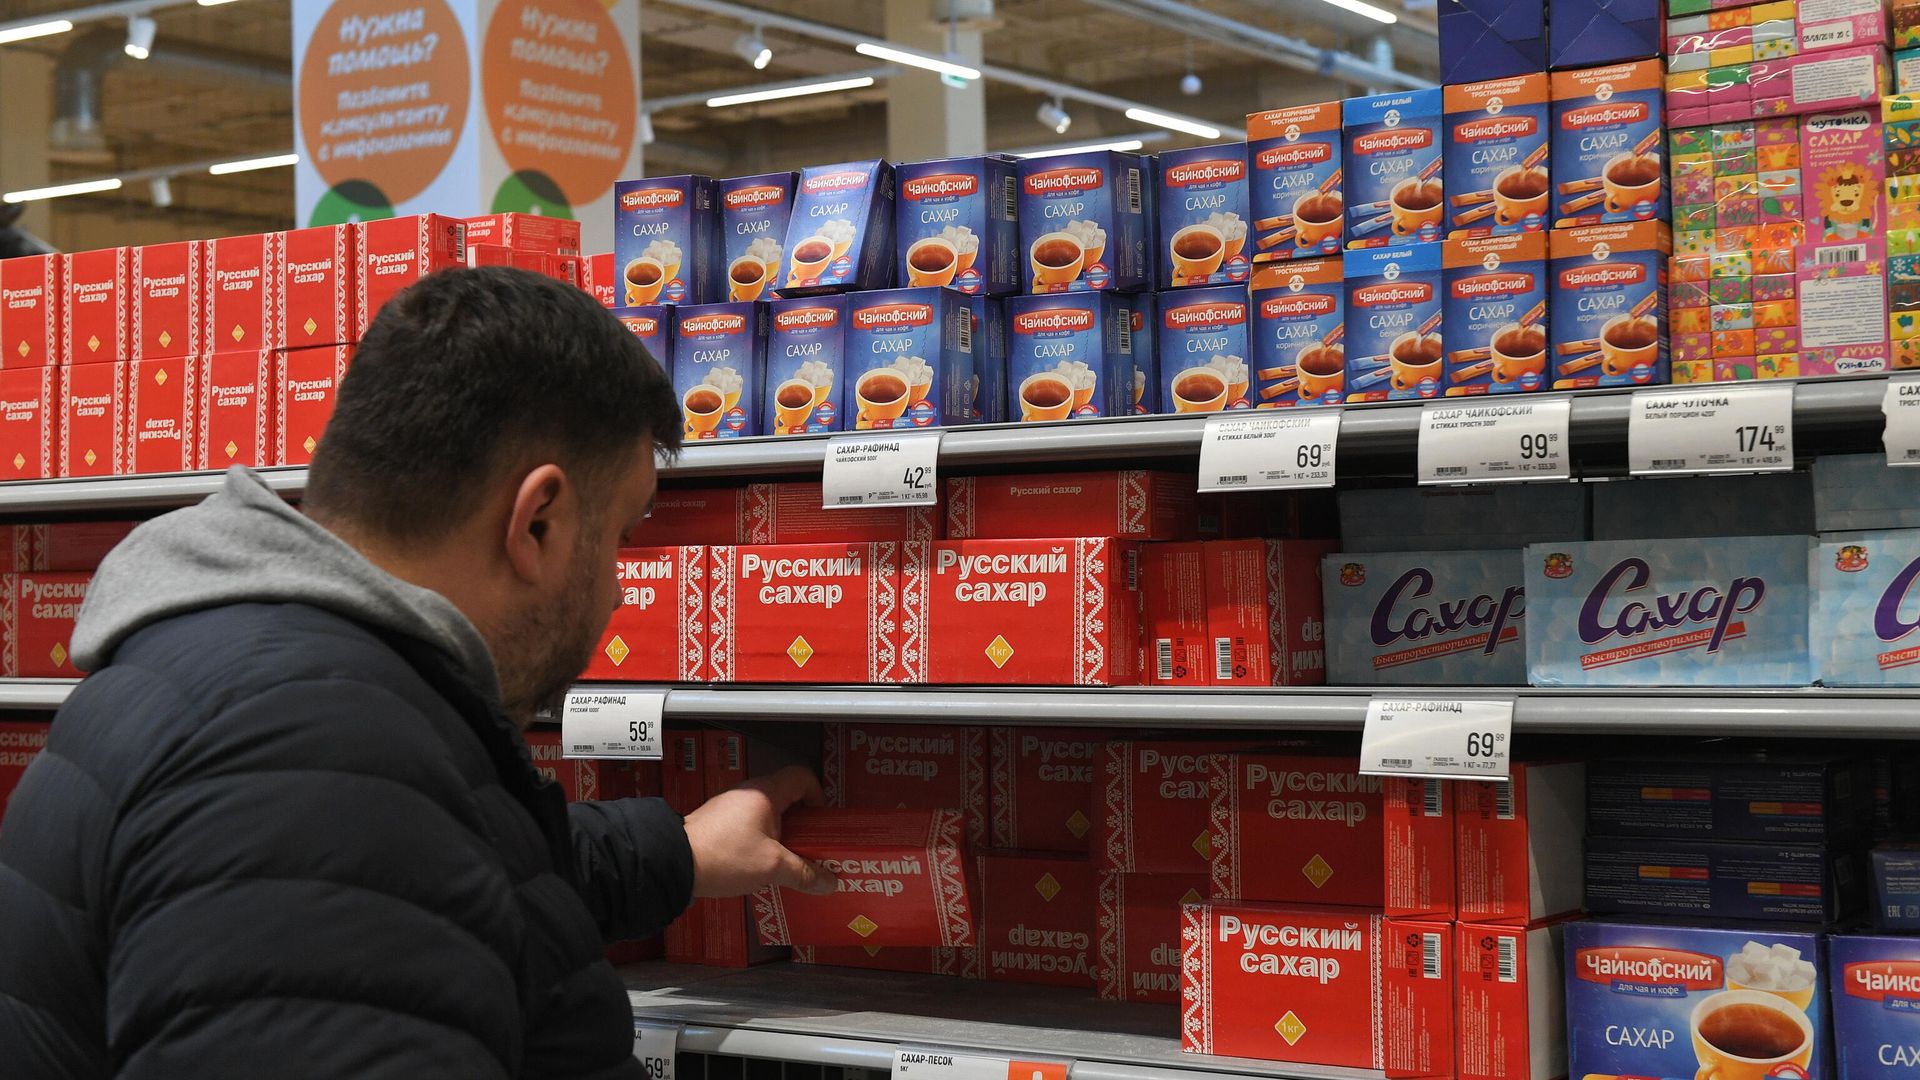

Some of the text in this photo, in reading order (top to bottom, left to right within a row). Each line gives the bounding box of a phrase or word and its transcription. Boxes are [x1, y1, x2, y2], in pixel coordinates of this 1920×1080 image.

[1569, 106, 1640, 126] Чайкофский
[1811, 115, 1868, 129] ЧУТОЧКА
[1461, 119, 1529, 138] Чайкофский
[1360, 131, 1424, 151] Чайкофский
[1580, 133, 1628, 151] САХАР
[1809, 131, 1863, 148] САХАР
[1262, 146, 1324, 166] Чайкофский
[1472, 147, 1518, 164] САХАР
[1171, 162, 1240, 183] Чайкофский
[1370, 159, 1414, 176] САХАР
[806, 173, 865, 191] Чайкофский
[907, 176, 972, 196] Чайкофский
[1029, 170, 1097, 190] Чайкофский
[1273, 173, 1314, 189] САХАР
[623, 188, 680, 207] Чайкофский
[727, 187, 781, 206] Чайкофский
[1185, 194, 1226, 211] САХАР
[810, 203, 848, 217] САХАР
[921, 208, 959, 224] САХАР
[1044, 202, 1085, 219] САХАР
[467, 218, 496, 231] усский
[633, 223, 669, 237] САХАР
[736, 220, 771, 235] САХАР
[368, 249, 415, 266] Русский
[216, 267, 260, 283] Русский
[287, 259, 331, 275] Русский
[375, 263, 408, 276] сахар
[1566, 266, 1637, 285] Чайкофский
[143, 273, 185, 289] Русский
[223, 278, 253, 292] сахар
[294, 271, 325, 284] сахар
[1458, 277, 1526, 294] Чайкофский
[2, 287, 42, 301] Русский
[73, 280, 113, 295] Русский
[149, 285, 179, 298] сахар
[1359, 286, 1424, 303] Чайкофский
[8, 298, 37, 309] сахар
[79, 291, 107, 303] сахар
[1578, 295, 1626, 311] САХАР
[858, 306, 927, 324] Чайкофский
[1171, 305, 1242, 324] Чайкофский
[1266, 298, 1328, 315] Чайкофский
[1469, 304, 1515, 320] САХАР
[683, 315, 742, 333] Чайкофский
[777, 310, 834, 328] Чайкофский
[1020, 311, 1088, 329] Чайкофский
[1369, 313, 1414, 329] САХАР
[1276, 324, 1318, 340] САХАР
[786, 342, 822, 357] САХАР
[872, 338, 913, 354] САХАР
[1034, 343, 1075, 358] САХАР
[1186, 337, 1228, 353] САХАР
[693, 349, 730, 364] САХАР
[212, 383, 254, 400] Русский
[288, 377, 332, 393] Русский
[71, 394, 111, 410] Русский
[217, 394, 248, 407] сахар
[294, 388, 326, 402] сахар
[5, 409, 33, 422] сахар
[76, 405, 105, 419] сахар
[1432, 410, 1463, 420] САХАР
[146, 418, 175, 431] сахар
[139, 427, 181, 442] Русский
[1735, 425, 1785, 452] 174 99
[836, 442, 900, 455] САХАР-РАФИНАД
[1520, 433, 1558, 459] 99 99
[1297, 443, 1332, 468] 69 99
[903, 466, 932, 489] 42 99
[1010, 485, 1082, 496] Русский сахар
[616, 554, 672, 579] ский
[741, 550, 861, 584] Русский
[936, 546, 1068, 579] Русский
[21, 578, 90, 602] Русски
[759, 582, 843, 610] сахар
[954, 578, 1047, 608] сахар
[1578, 557, 1767, 653] Сахар
[1373, 633, 1488, 666] Быстрорастворимый
[1580, 629, 1713, 665] Быстрорастворимый
[570, 696, 627, 705] САХАР-РАФИНАД
[1382, 702, 1463, 713] САХАР-РАФИНАД
[629, 721, 654, 742] 59 99
[850, 729, 955, 756] Русский
[1467, 732, 1505, 757] 69 99
[865, 756, 938, 781] сахар
[1139, 750, 1209, 778] Русс
[1159, 780, 1209, 799] сах
[1267, 799, 1367, 828] сахар
[823, 855, 921, 875] сский
[1008, 923, 1089, 950] сахар
[1219, 915, 1362, 951] Русский
[1239, 951, 1340, 985] сахар
[1586, 952, 1712, 982] Чайкофский
[1856, 965, 1920, 992] Чайко
[1618, 984, 1680, 996] для чая и кофе
[1605, 1025, 1675, 1049] САХАР
[901, 1053, 953, 1066] САХАР-ПЕСОК
[1878, 1044, 1920, 1067] САХ
[645, 1057, 663, 1079] 59
